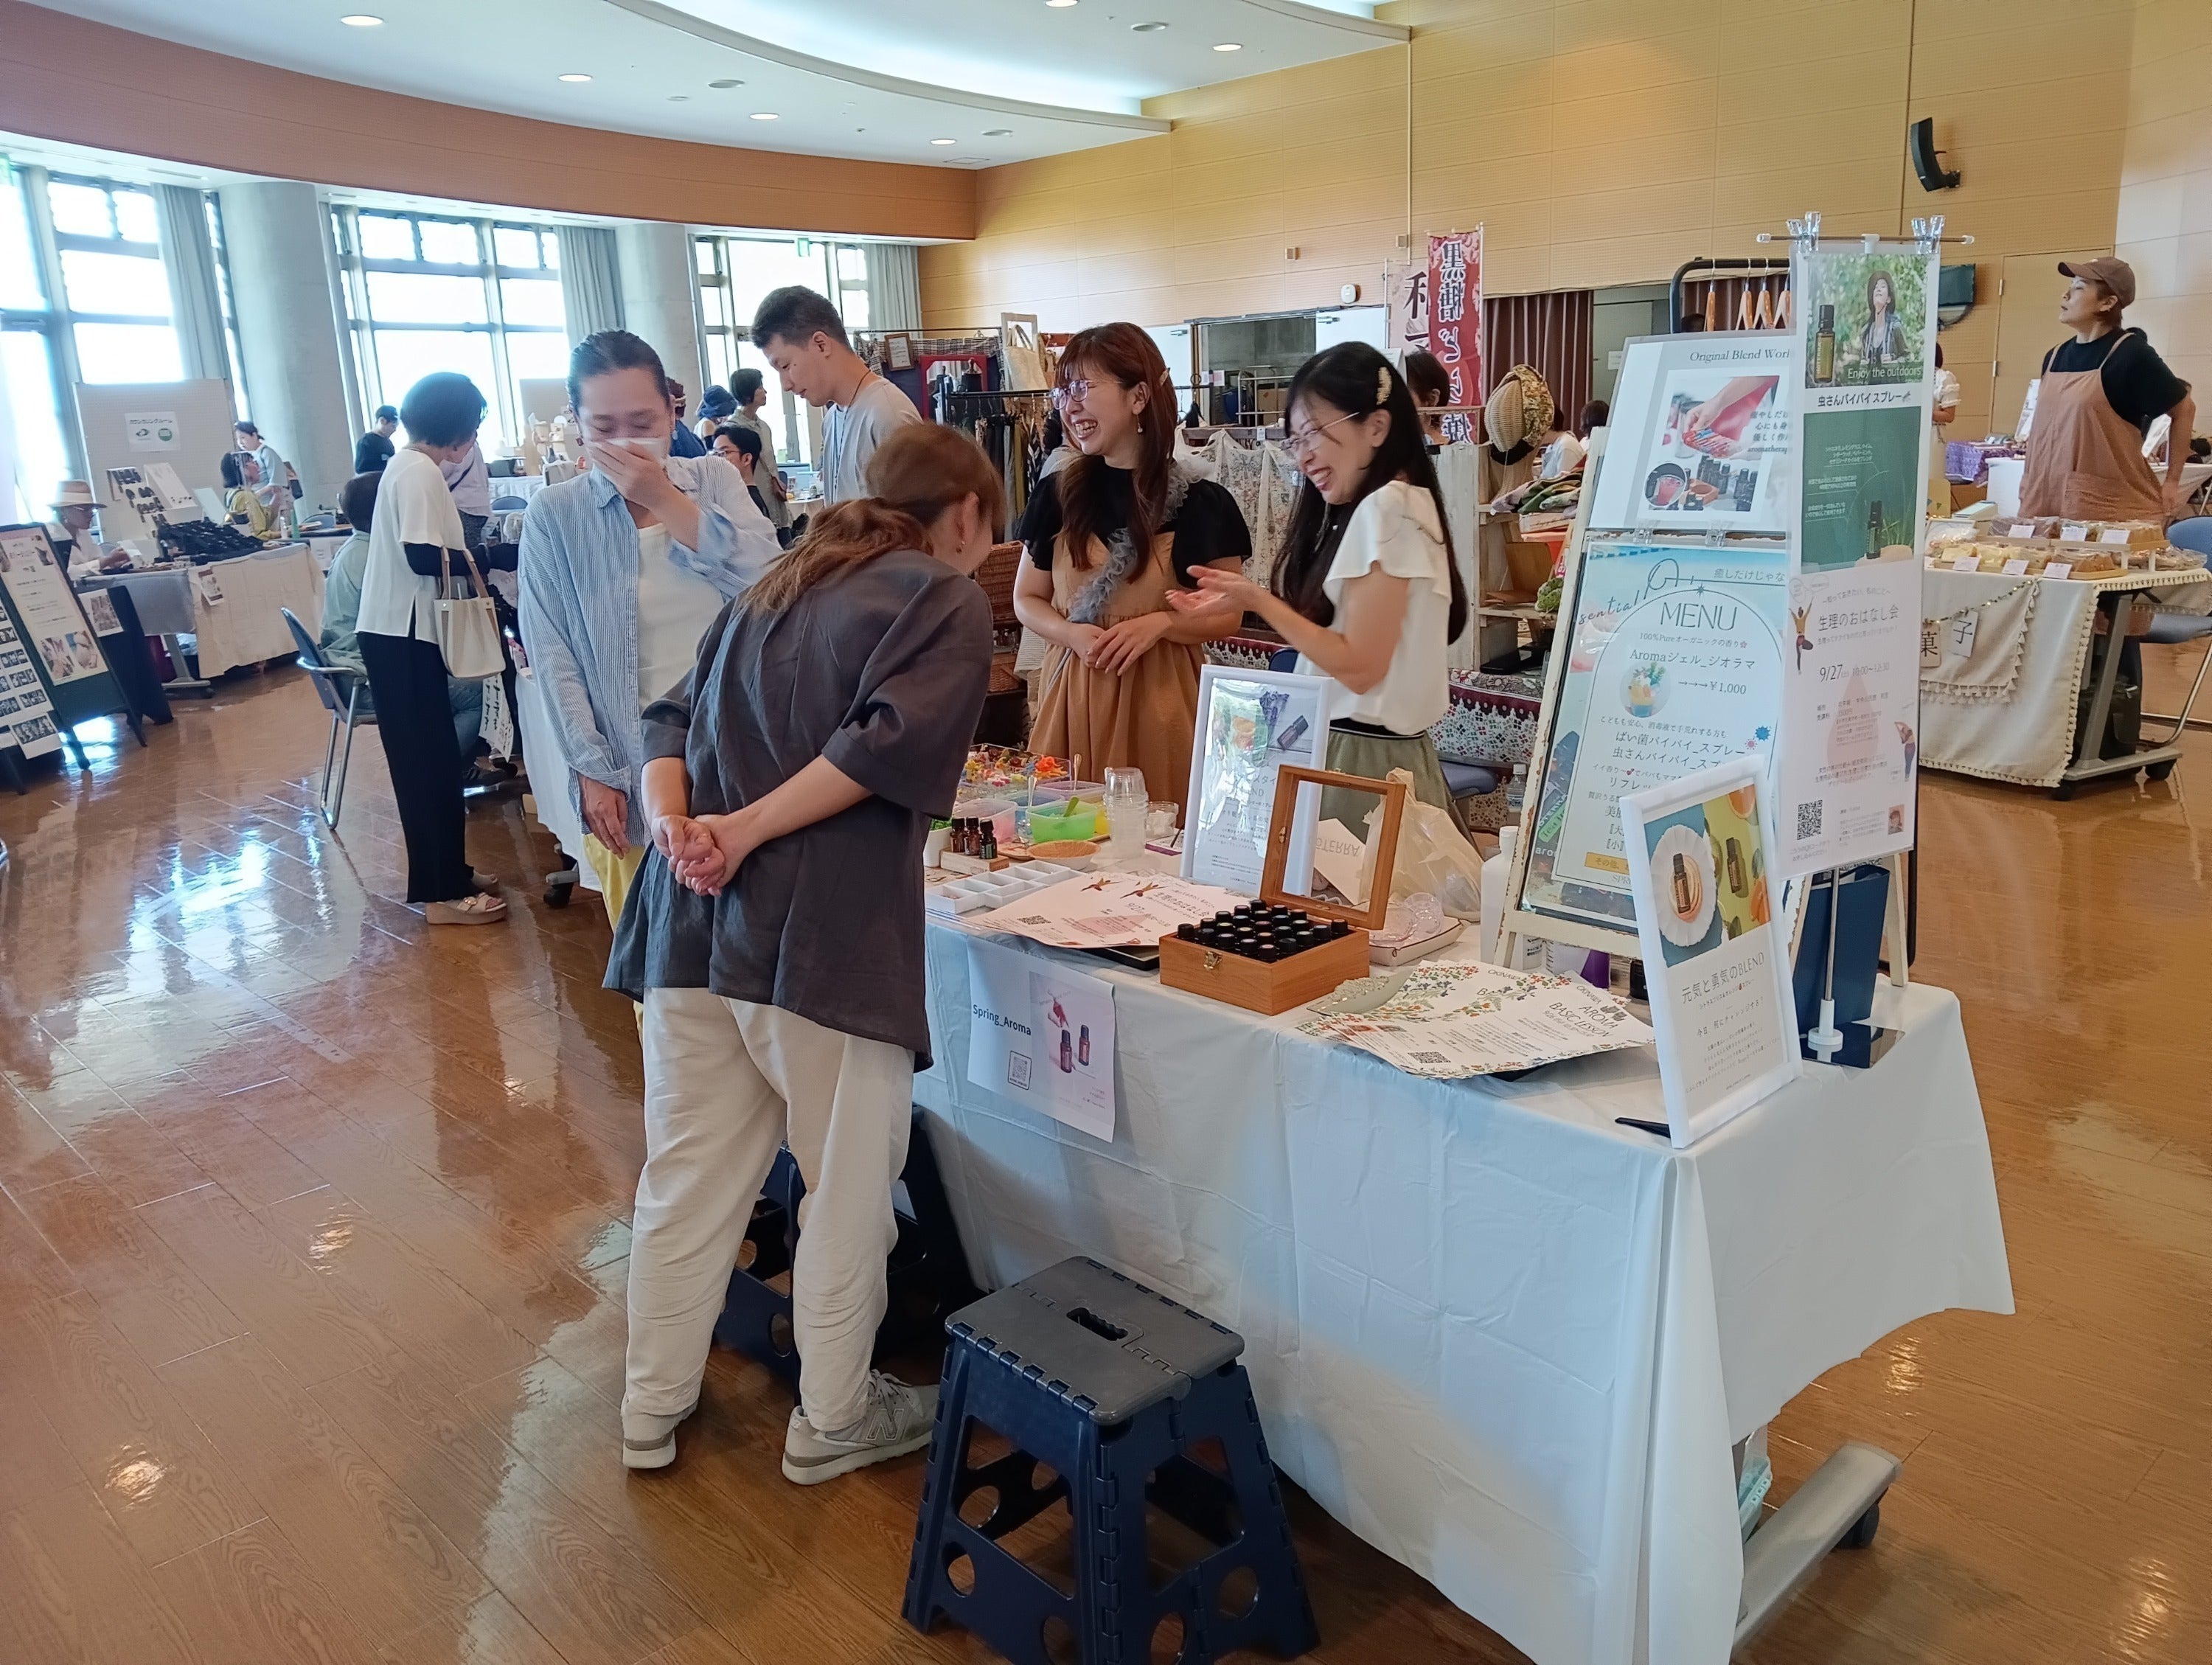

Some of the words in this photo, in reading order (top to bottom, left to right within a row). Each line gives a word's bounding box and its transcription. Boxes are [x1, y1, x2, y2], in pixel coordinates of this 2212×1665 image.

[1690, 350, 1729, 364] Original
[1732, 349, 1761, 360] Blend
[1848, 369, 1870, 380] Enjoy
[1872, 368, 1885, 378] the
[1887, 367, 1921, 376] outdoors
[1660, 602, 1738, 631] MENU
[1818, 604, 1899, 632] 生理のおはなし会
[1682, 951, 1764, 1004] 元気と勇気のBLEND
[973, 1004, 1032, 1036] Spring_Aroma
[1549, 1002, 1581, 1023] BASIC
[1579, 1004, 1619, 1029] AROMA
